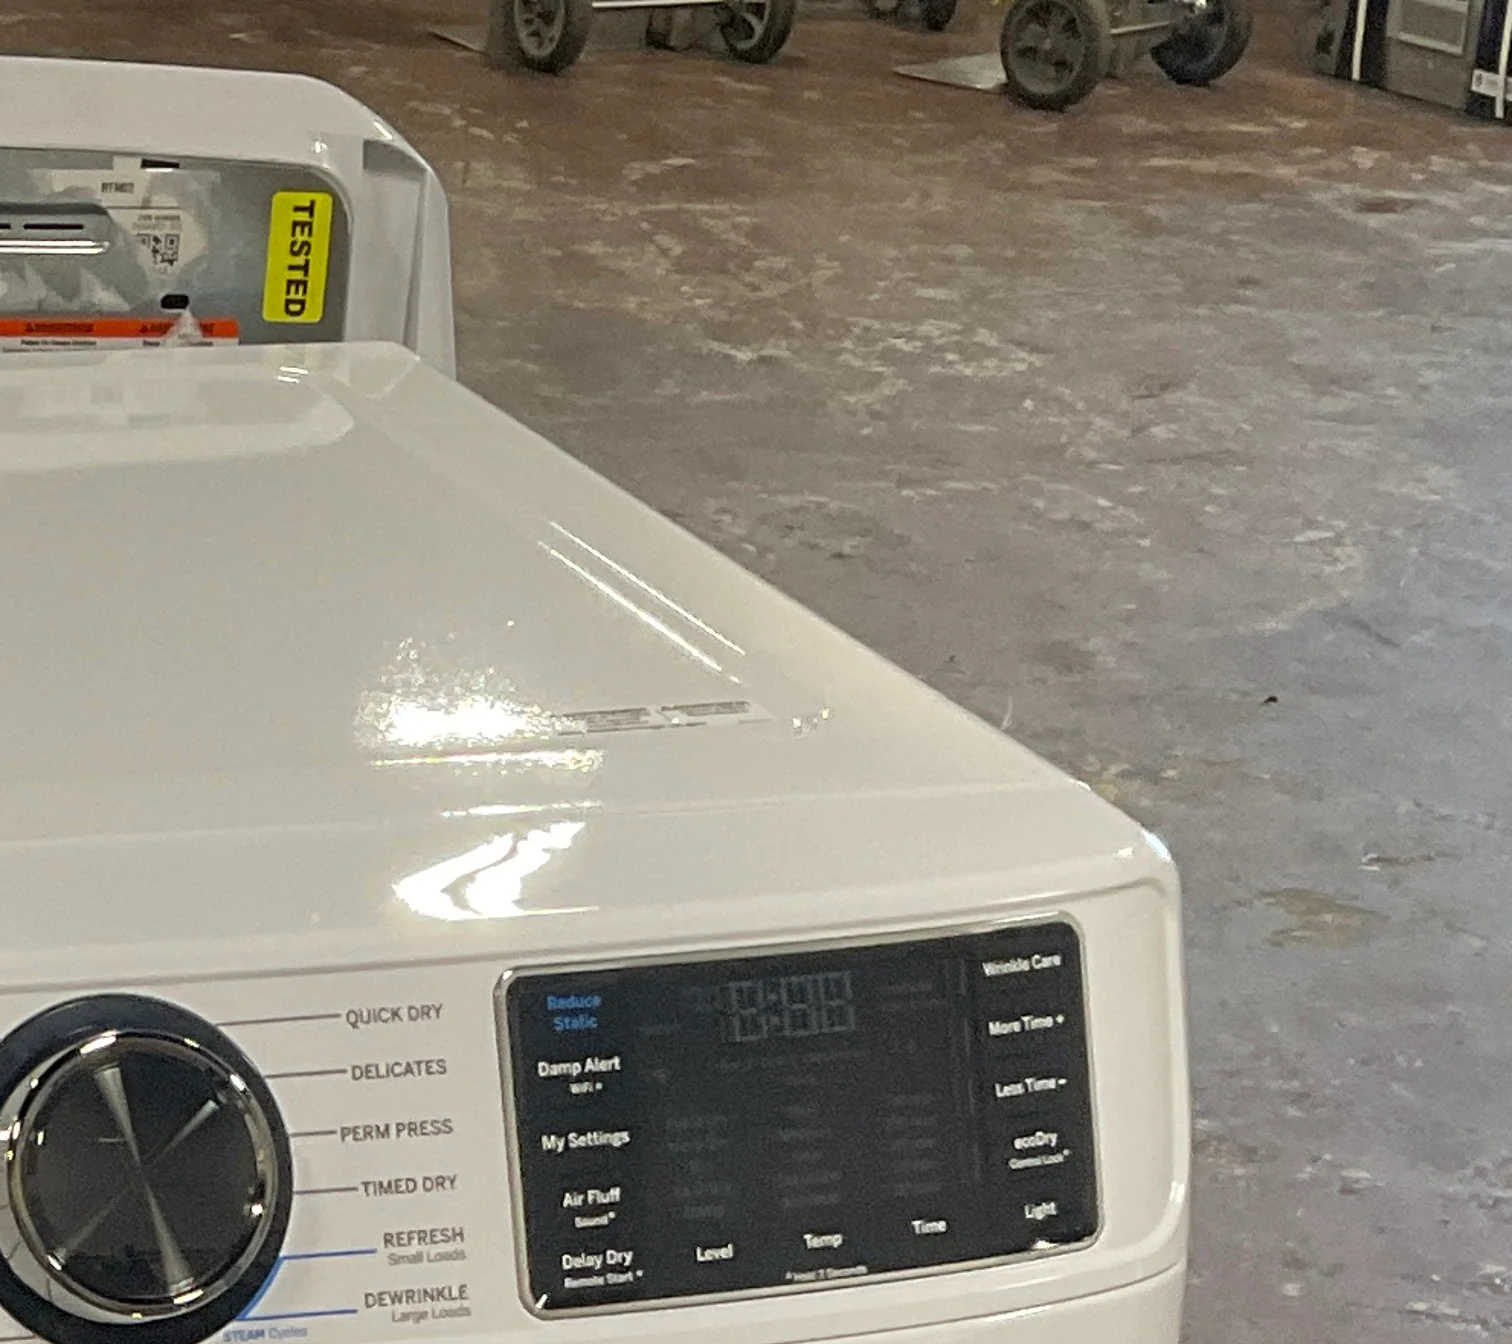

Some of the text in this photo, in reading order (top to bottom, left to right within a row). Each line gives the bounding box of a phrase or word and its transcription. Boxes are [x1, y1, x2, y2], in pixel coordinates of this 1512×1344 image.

[282, 199, 317, 318] TESTED
[1032, 953, 1062, 970] Care
[345, 1003, 443, 1029] QUICK DRY
[988, 1020, 1023, 1036] More
[1021, 1014, 1054, 1031] Time
[351, 1058, 448, 1081] DELICATES
[537, 1055, 621, 1077] Damp Alert
[994, 1082, 1025, 1098] Less
[1024, 1077, 1056, 1093] Time
[340, 1118, 454, 1143] PERM PRESS
[541, 1130, 630, 1153] My Settings
[361, 1174, 458, 1197] TIMED DRY
[562, 1186, 621, 1208] Air Fluff
[383, 1226, 465, 1249] REFRESH
[911, 1219, 948, 1235] Time
[695, 1243, 734, 1262] Level
[803, 1233, 843, 1250] Temp
[387, 1246, 467, 1266] Small Loads
[561, 1249, 634, 1270] Delay Dry
[364, 1284, 468, 1309] DEWRINKLE
[391, 1303, 472, 1325] Large Loads
[222, 1328, 266, 1344] STEAM
